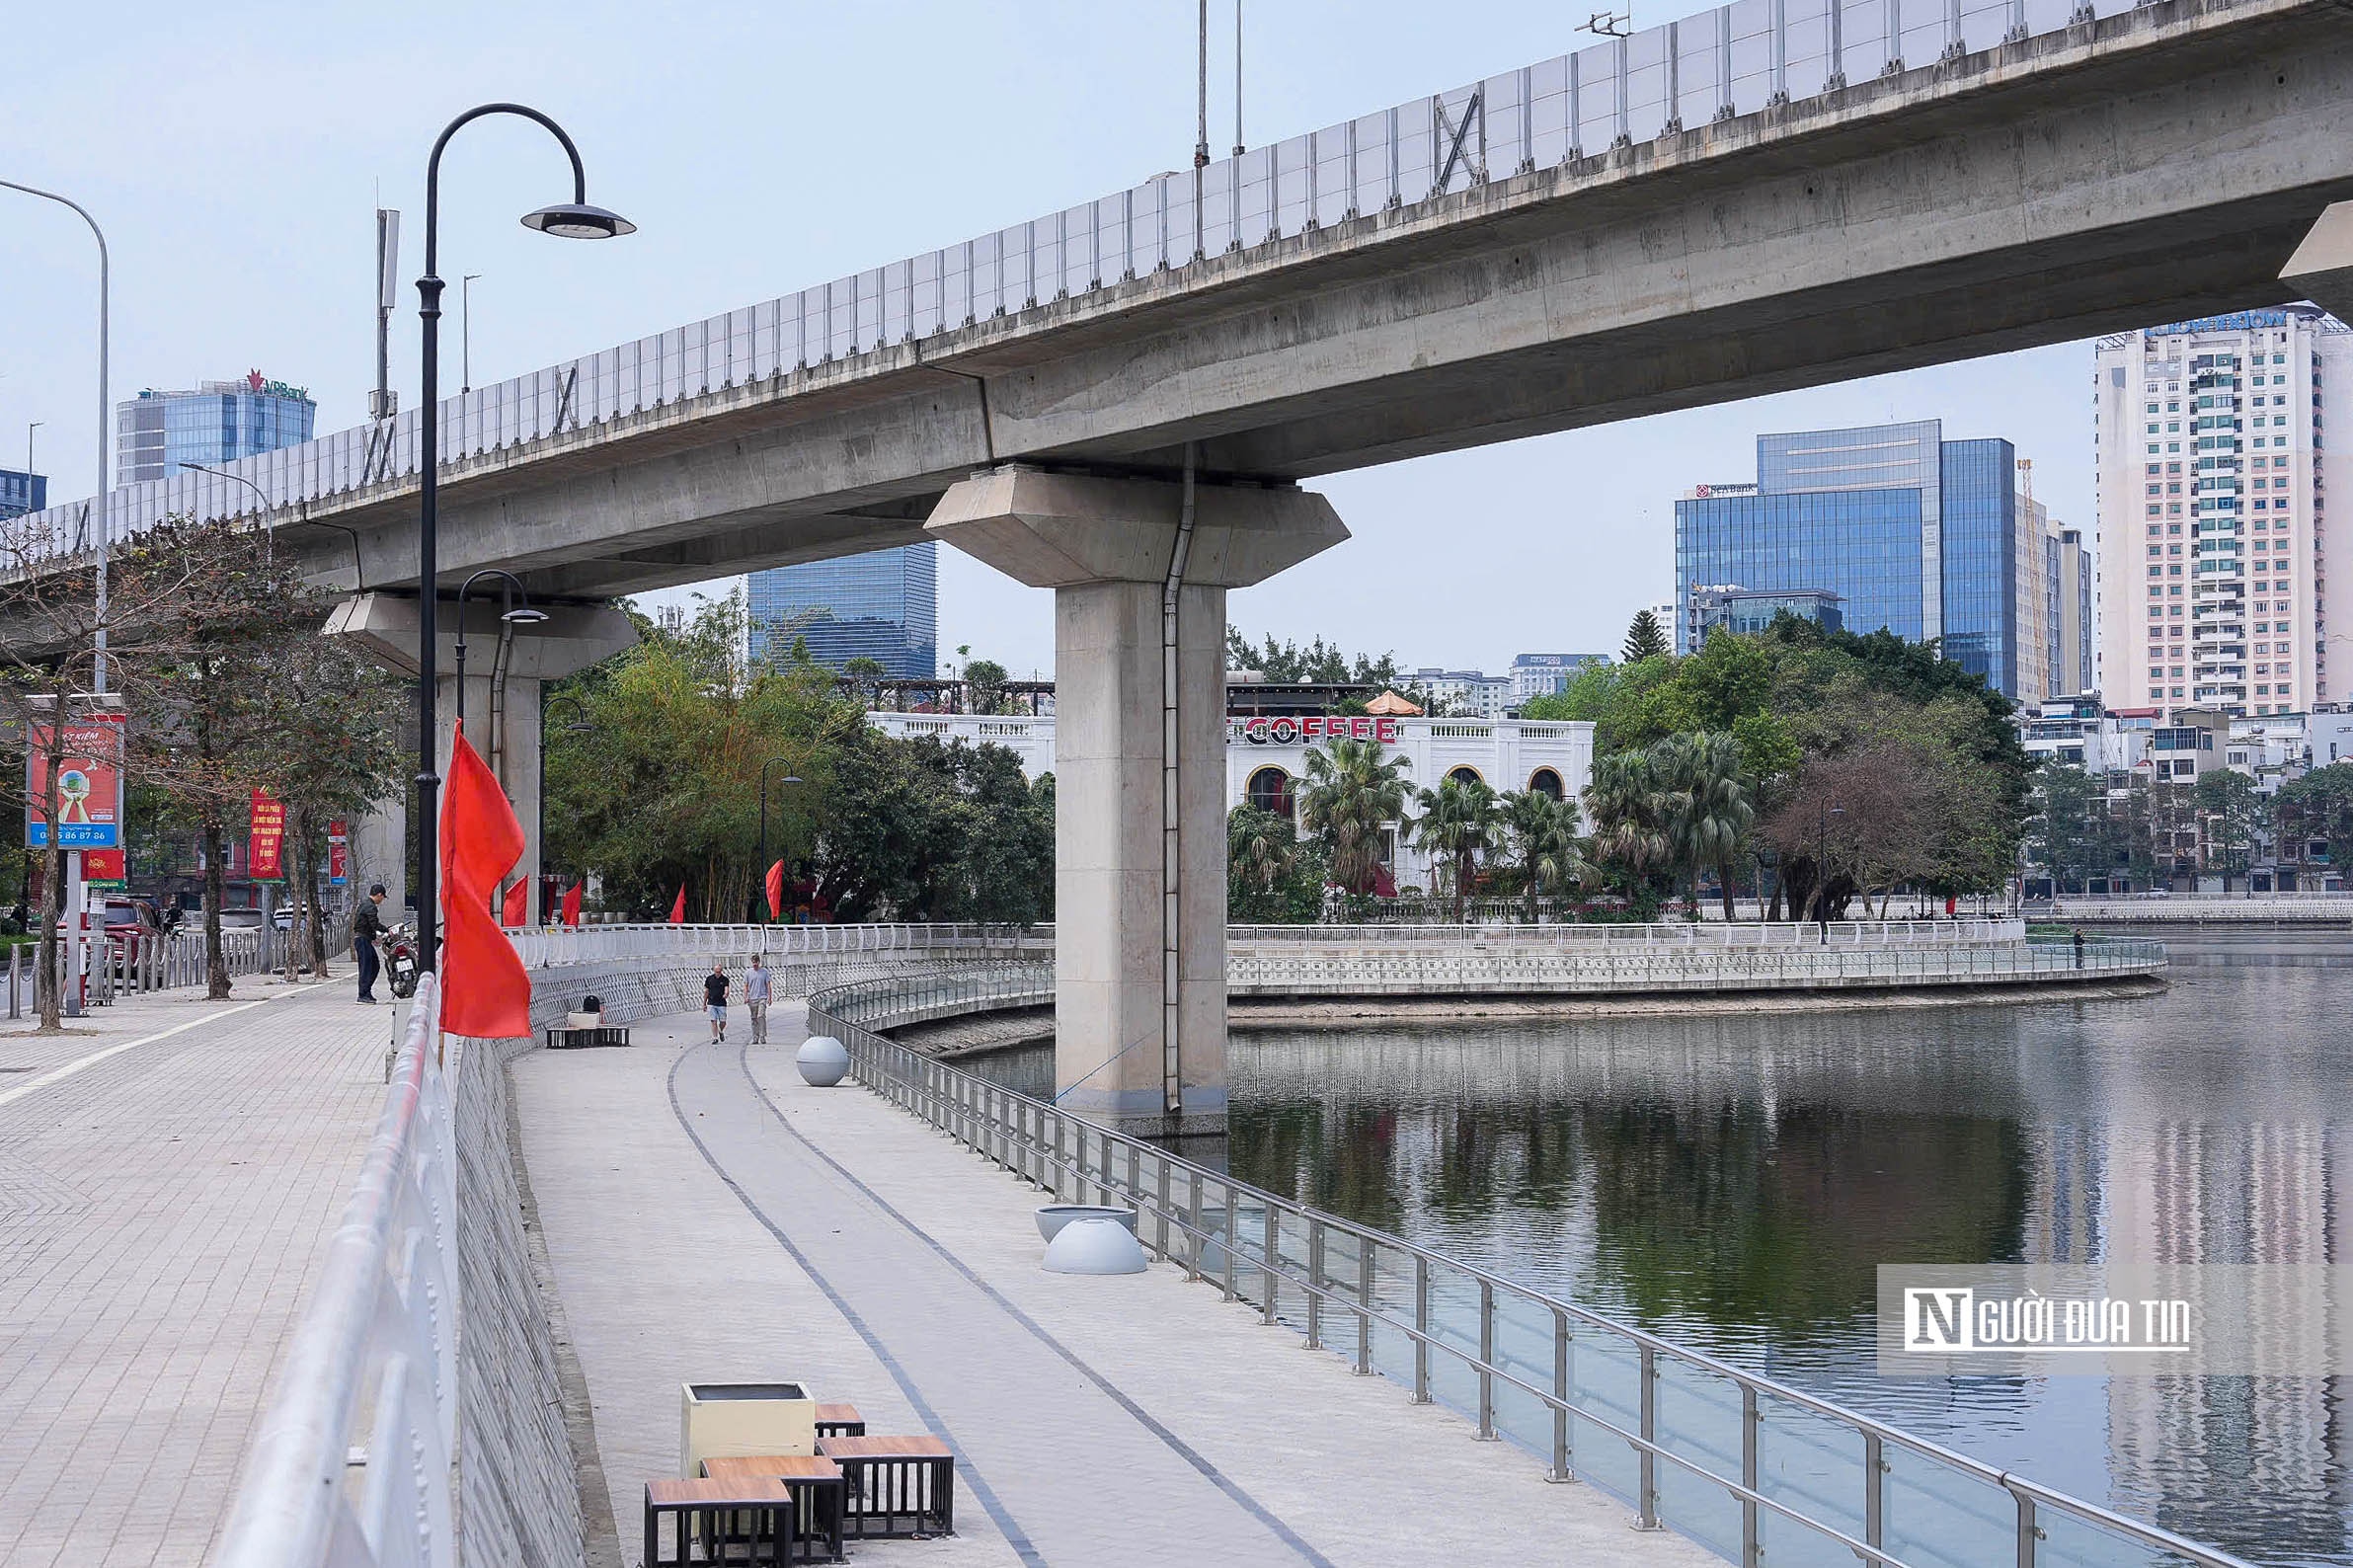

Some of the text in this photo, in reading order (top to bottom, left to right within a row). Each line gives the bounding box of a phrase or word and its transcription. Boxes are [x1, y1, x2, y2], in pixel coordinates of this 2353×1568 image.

[266, 379, 309, 400] VPBank
[1710, 483, 1754, 494] SeABank
[1245, 717, 1396, 745] COFFEE
